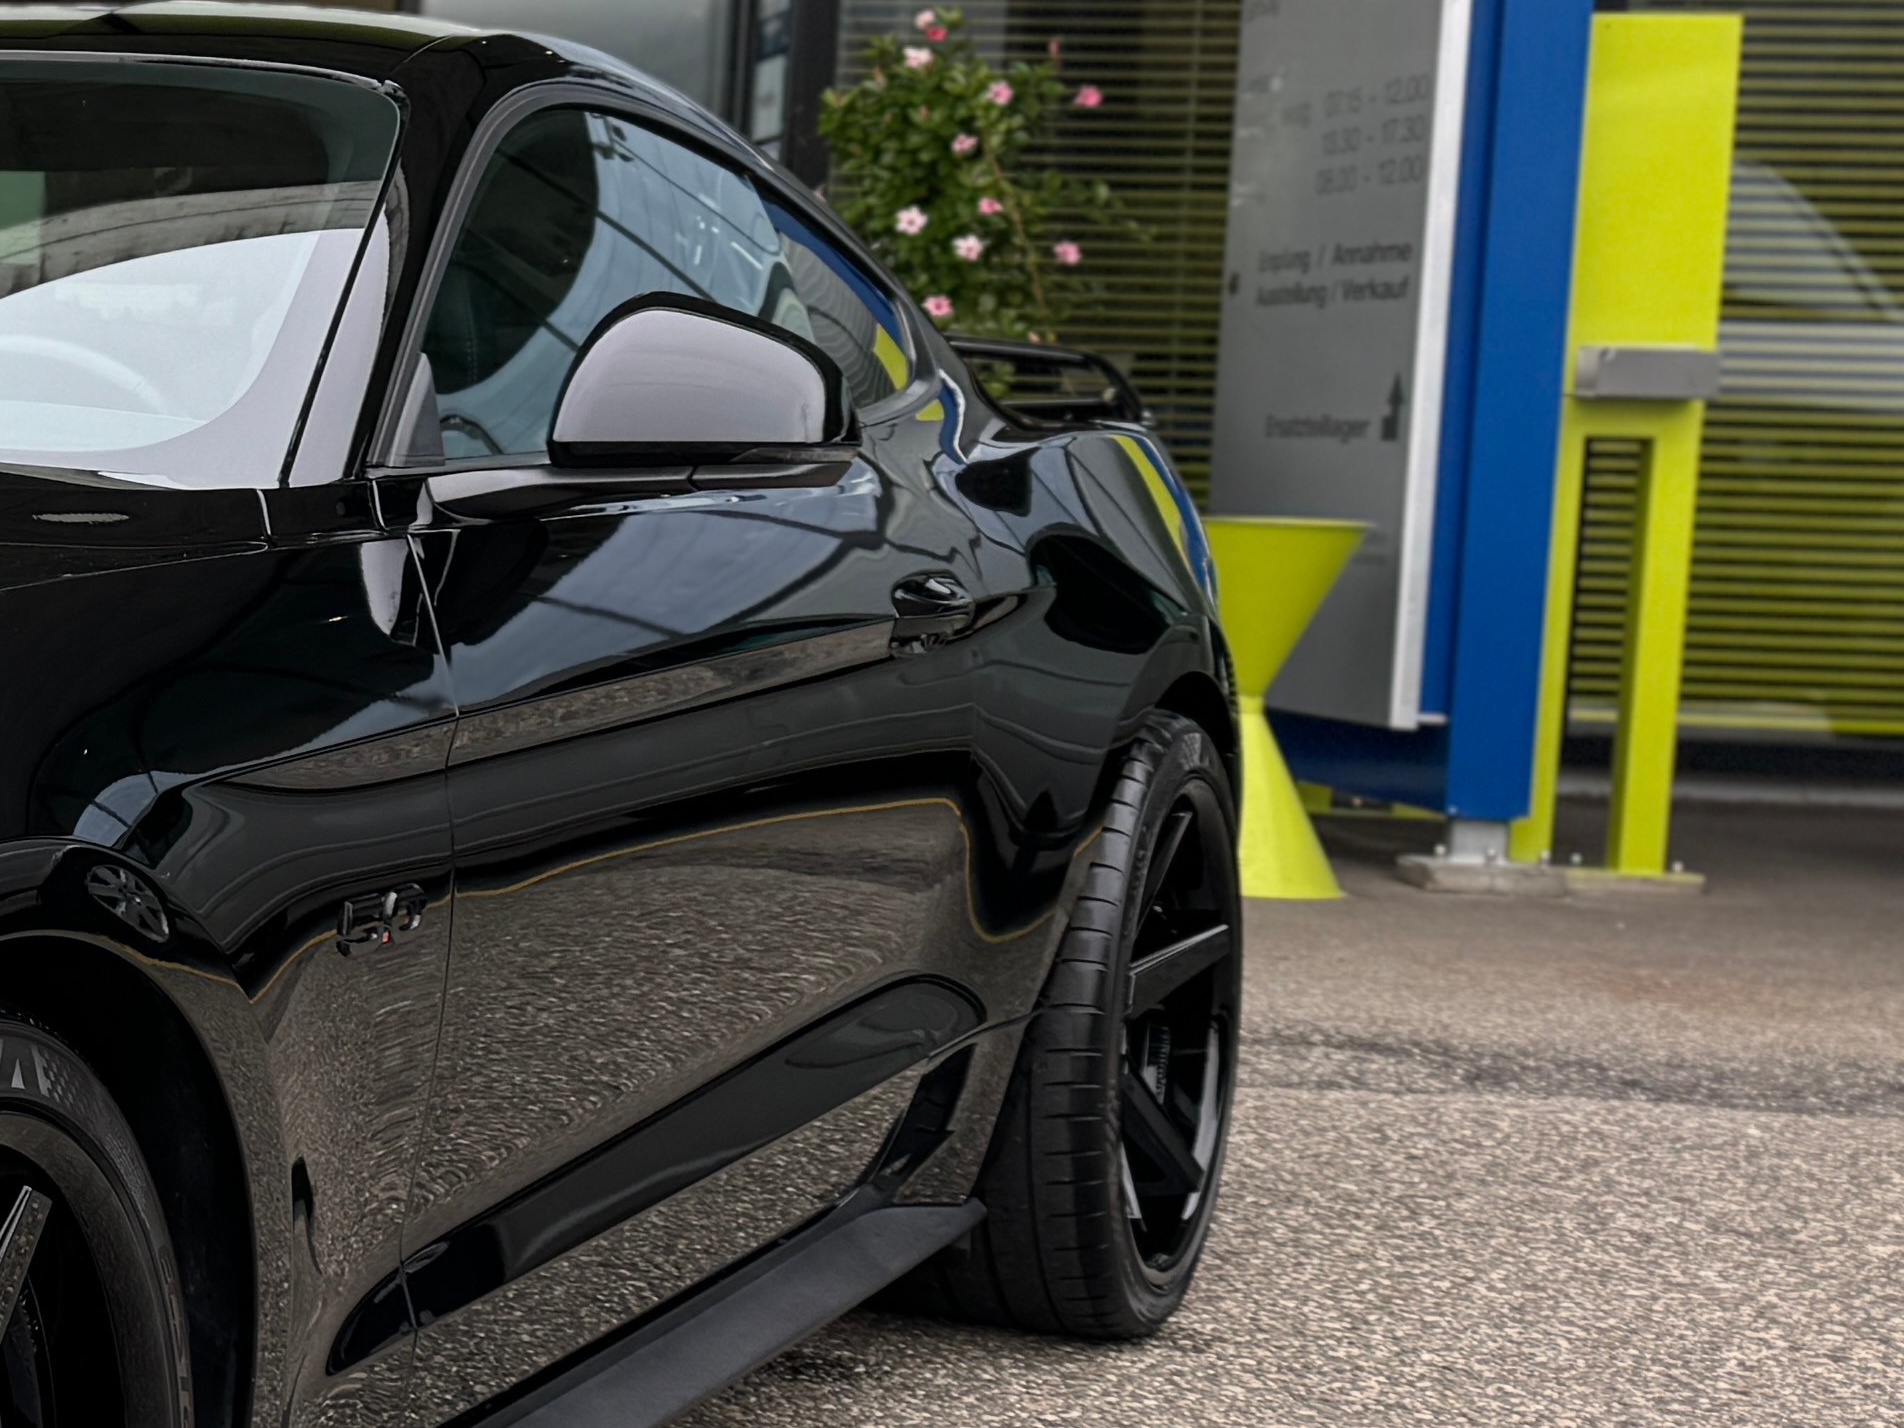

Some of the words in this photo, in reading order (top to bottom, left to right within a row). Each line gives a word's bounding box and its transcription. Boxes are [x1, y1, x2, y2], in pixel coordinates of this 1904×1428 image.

[1383, 73, 1430, 105] 12.00
[1378, 153, 1424, 186] 12.00
[1331, 239, 1412, 265] Annahme
[1340, 274, 1410, 302] Verkauf
